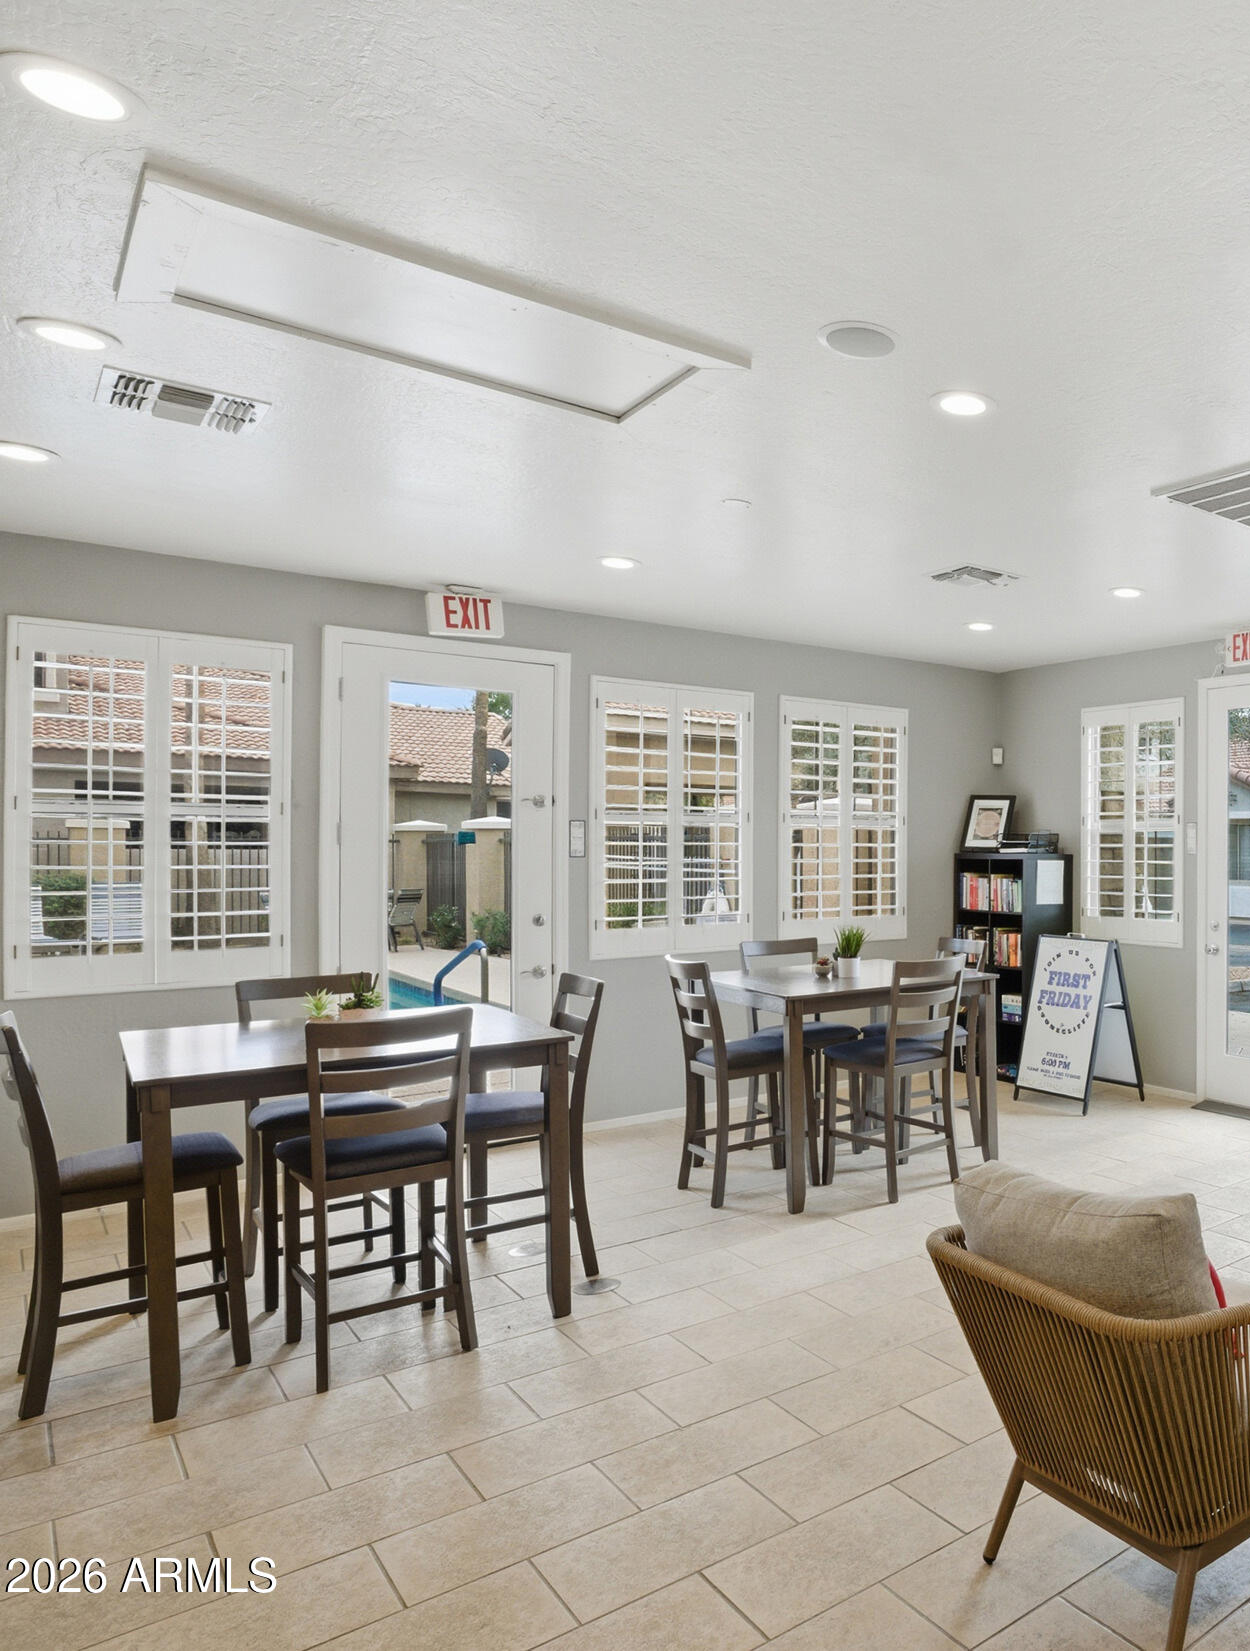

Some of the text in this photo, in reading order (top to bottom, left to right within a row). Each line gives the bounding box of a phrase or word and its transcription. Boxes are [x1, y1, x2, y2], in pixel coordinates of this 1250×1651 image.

[443, 595, 492, 631] EXIT
[1043, 952, 1061, 972] JOIN
[1085, 957, 1097, 977] FOR
[1047, 970, 1091, 990] FIRST
[1037, 989, 1092, 1011] FRIDAY
[1041, 1057, 1071, 1070] 6:00 PM
